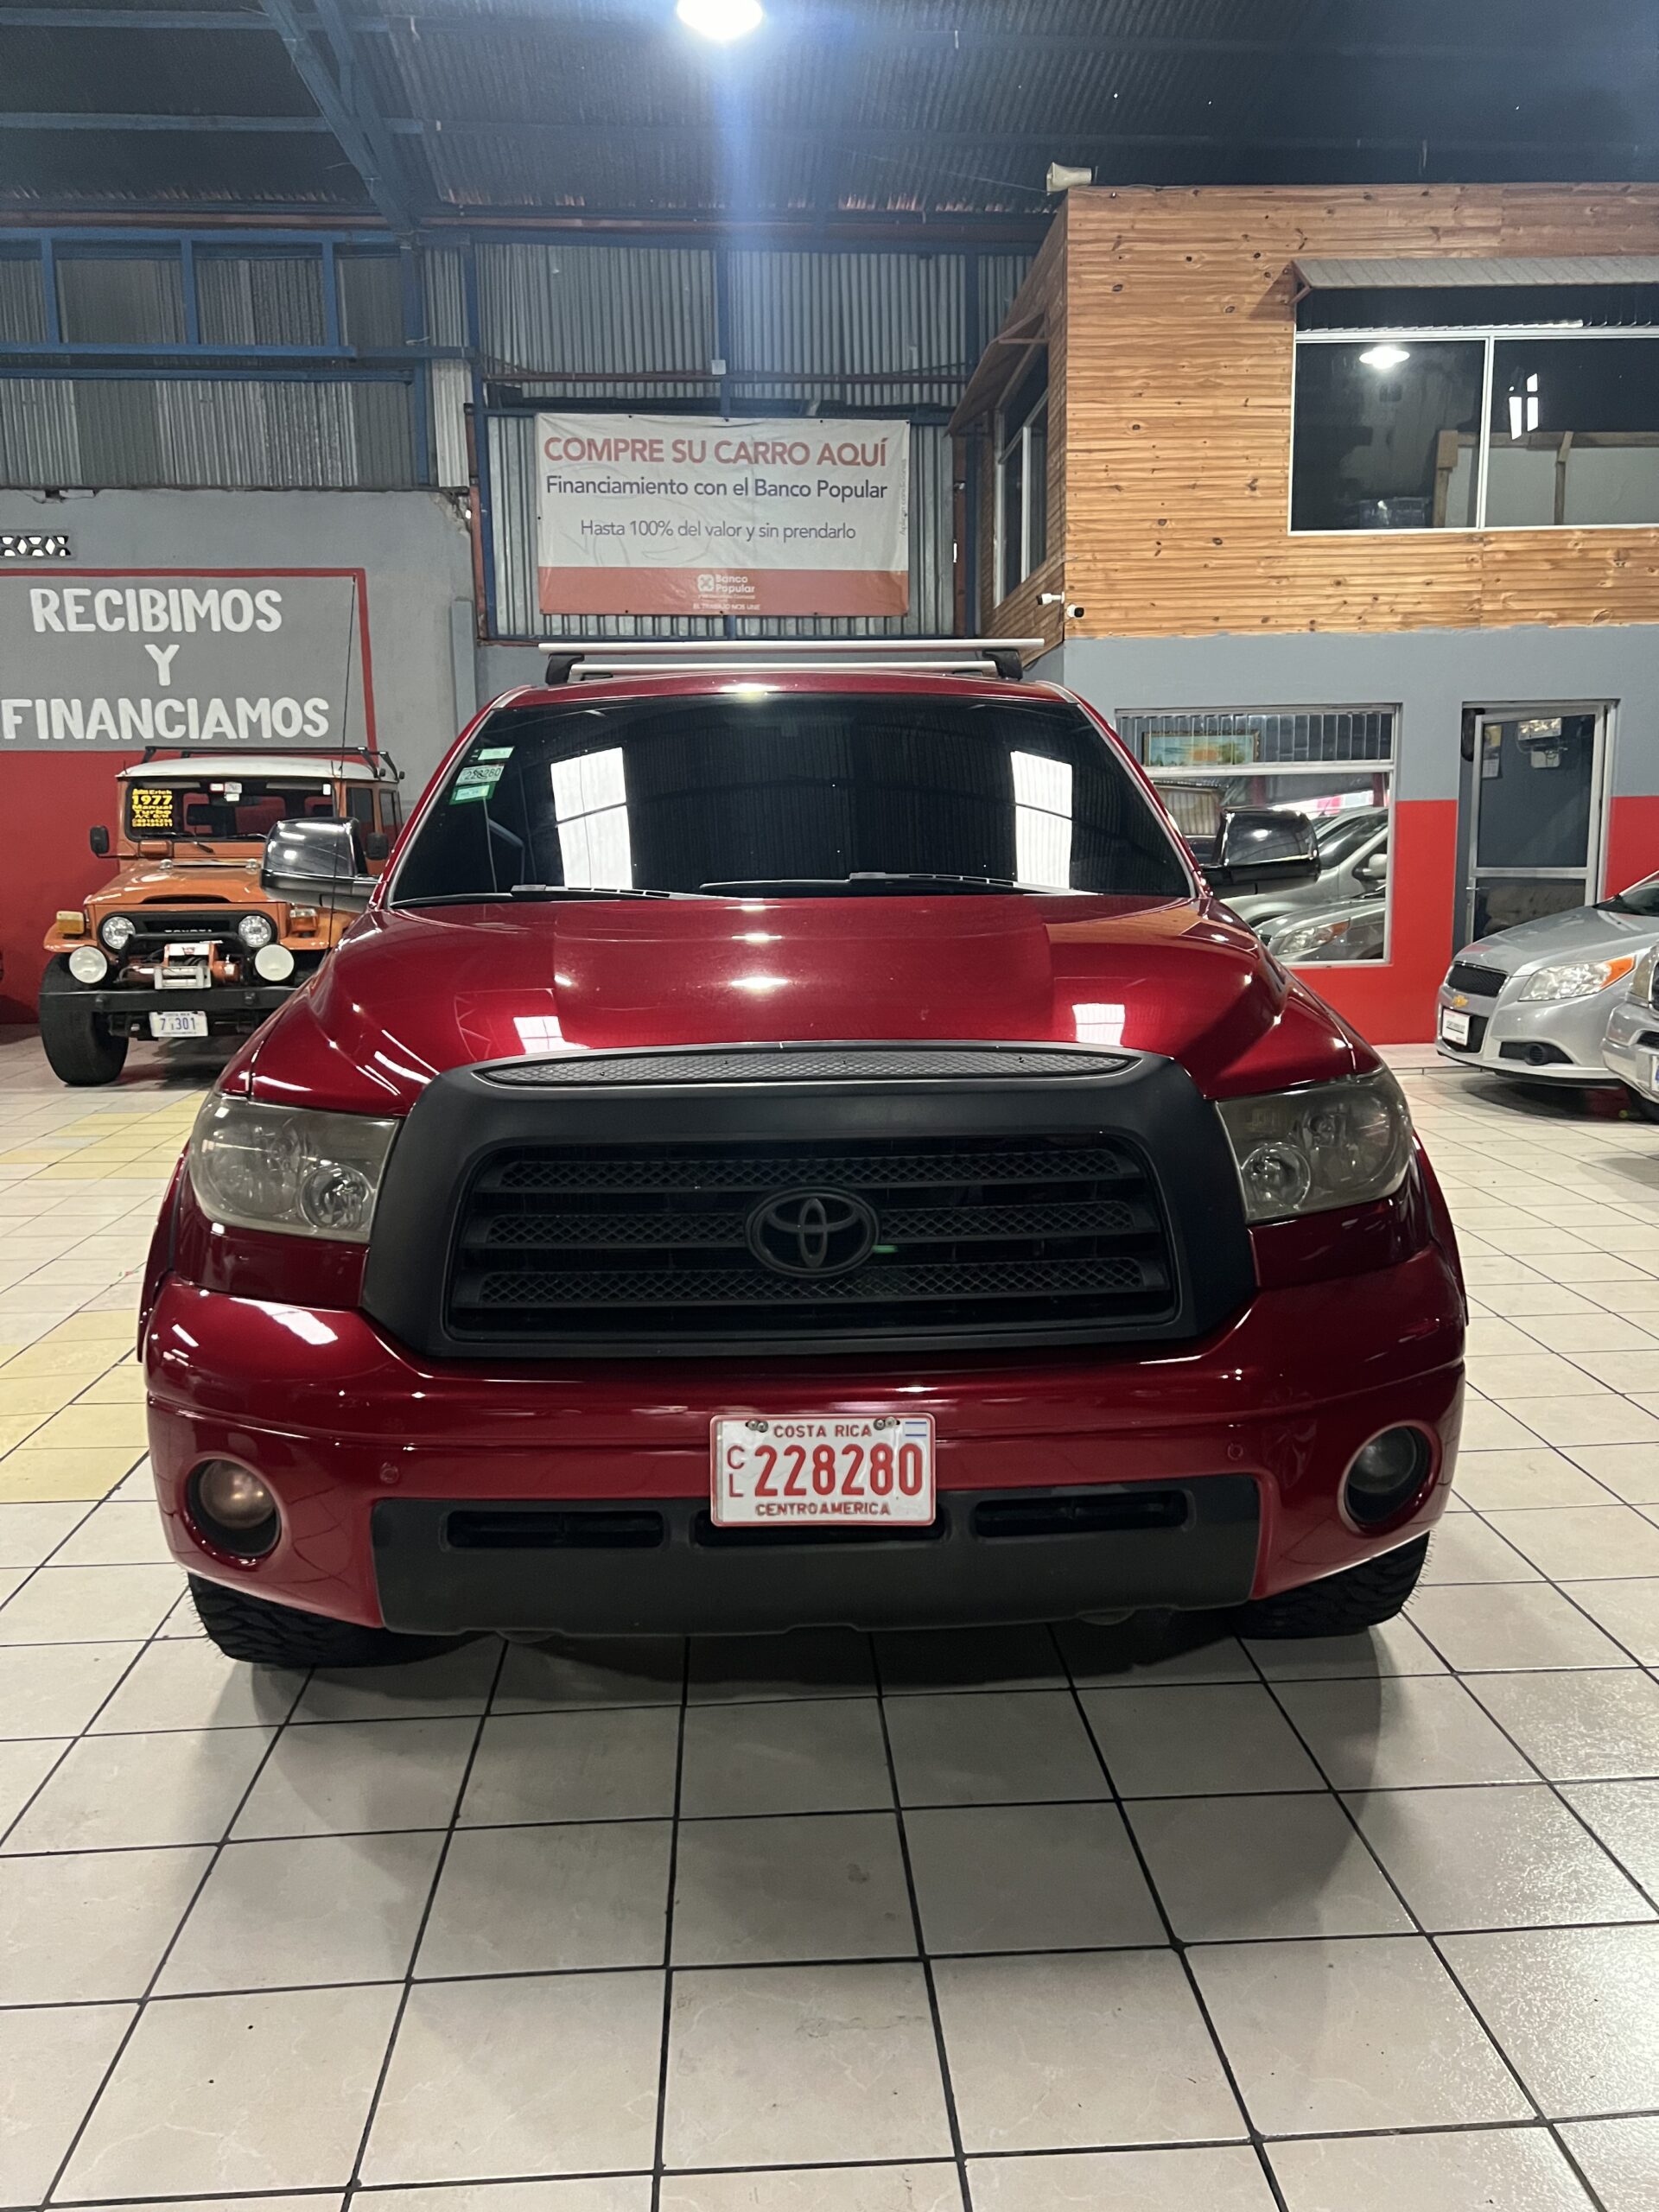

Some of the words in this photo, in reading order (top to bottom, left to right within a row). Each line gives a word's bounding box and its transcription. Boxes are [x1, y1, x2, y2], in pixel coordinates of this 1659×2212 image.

[543, 436, 664, 462] COMPRE
[671, 439, 707, 464] SU
[714, 441, 810, 466] CARRO
[817, 437, 887, 467] AQUÍ
[546, 475, 689, 496] Financiamiento
[694, 482, 727, 496] con
[733, 477, 749, 497] el
[754, 479, 811, 498] Banco
[817, 479, 887, 503] Popular
[581, 519, 625, 537] Hasta
[630, 520, 673, 537] 100%
[677, 520, 701, 537] del
[704, 520, 742, 538] valor
[745, 526, 753, 543] y
[758, 523, 779, 539] sin
[783, 522, 856, 543] prendarlo
[715, 574, 748, 583] Banco
[715, 583, 755, 594] Popular
[29, 588, 283, 632] RECIBIMOS
[144, 644, 180, 686] Y
[1, 696, 330, 741] FINANCIAMOS
[132, 795, 173, 804] 1977
[774, 1424, 826, 1438] COSTA
[835, 1424, 872, 1438] RICA
[754, 1443, 923, 1497] 228280
[755, 1502, 891, 1516] CENTROAMERICA
